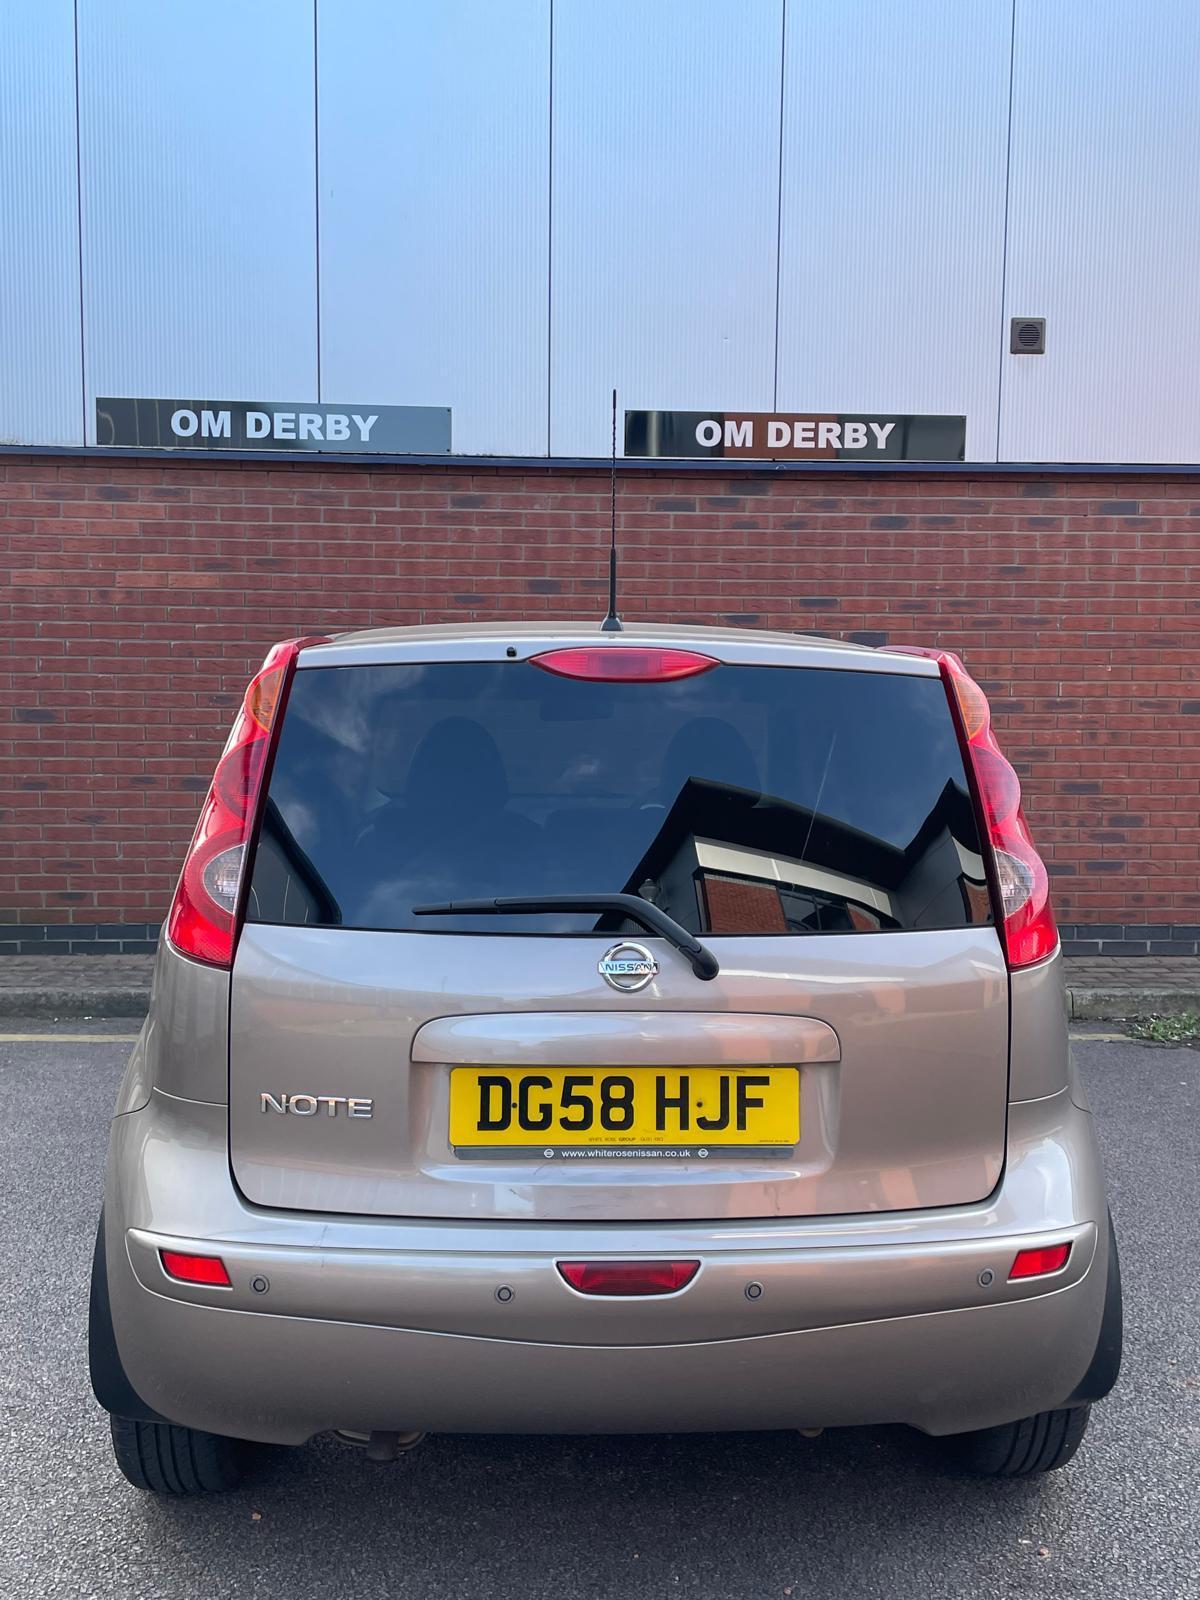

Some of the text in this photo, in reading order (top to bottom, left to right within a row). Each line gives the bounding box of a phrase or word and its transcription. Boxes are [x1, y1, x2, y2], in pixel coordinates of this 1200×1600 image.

[170, 409, 379, 442] OM DERBY
[695, 420, 896, 449] OM DERBY
[605, 962, 653, 972] NISSAN
[260, 1093, 373, 1118] NOTE
[477, 1075, 771, 1131] DG58 HJF
[561, 1149, 691, 1158] www.whiterosenissan.co.uk
